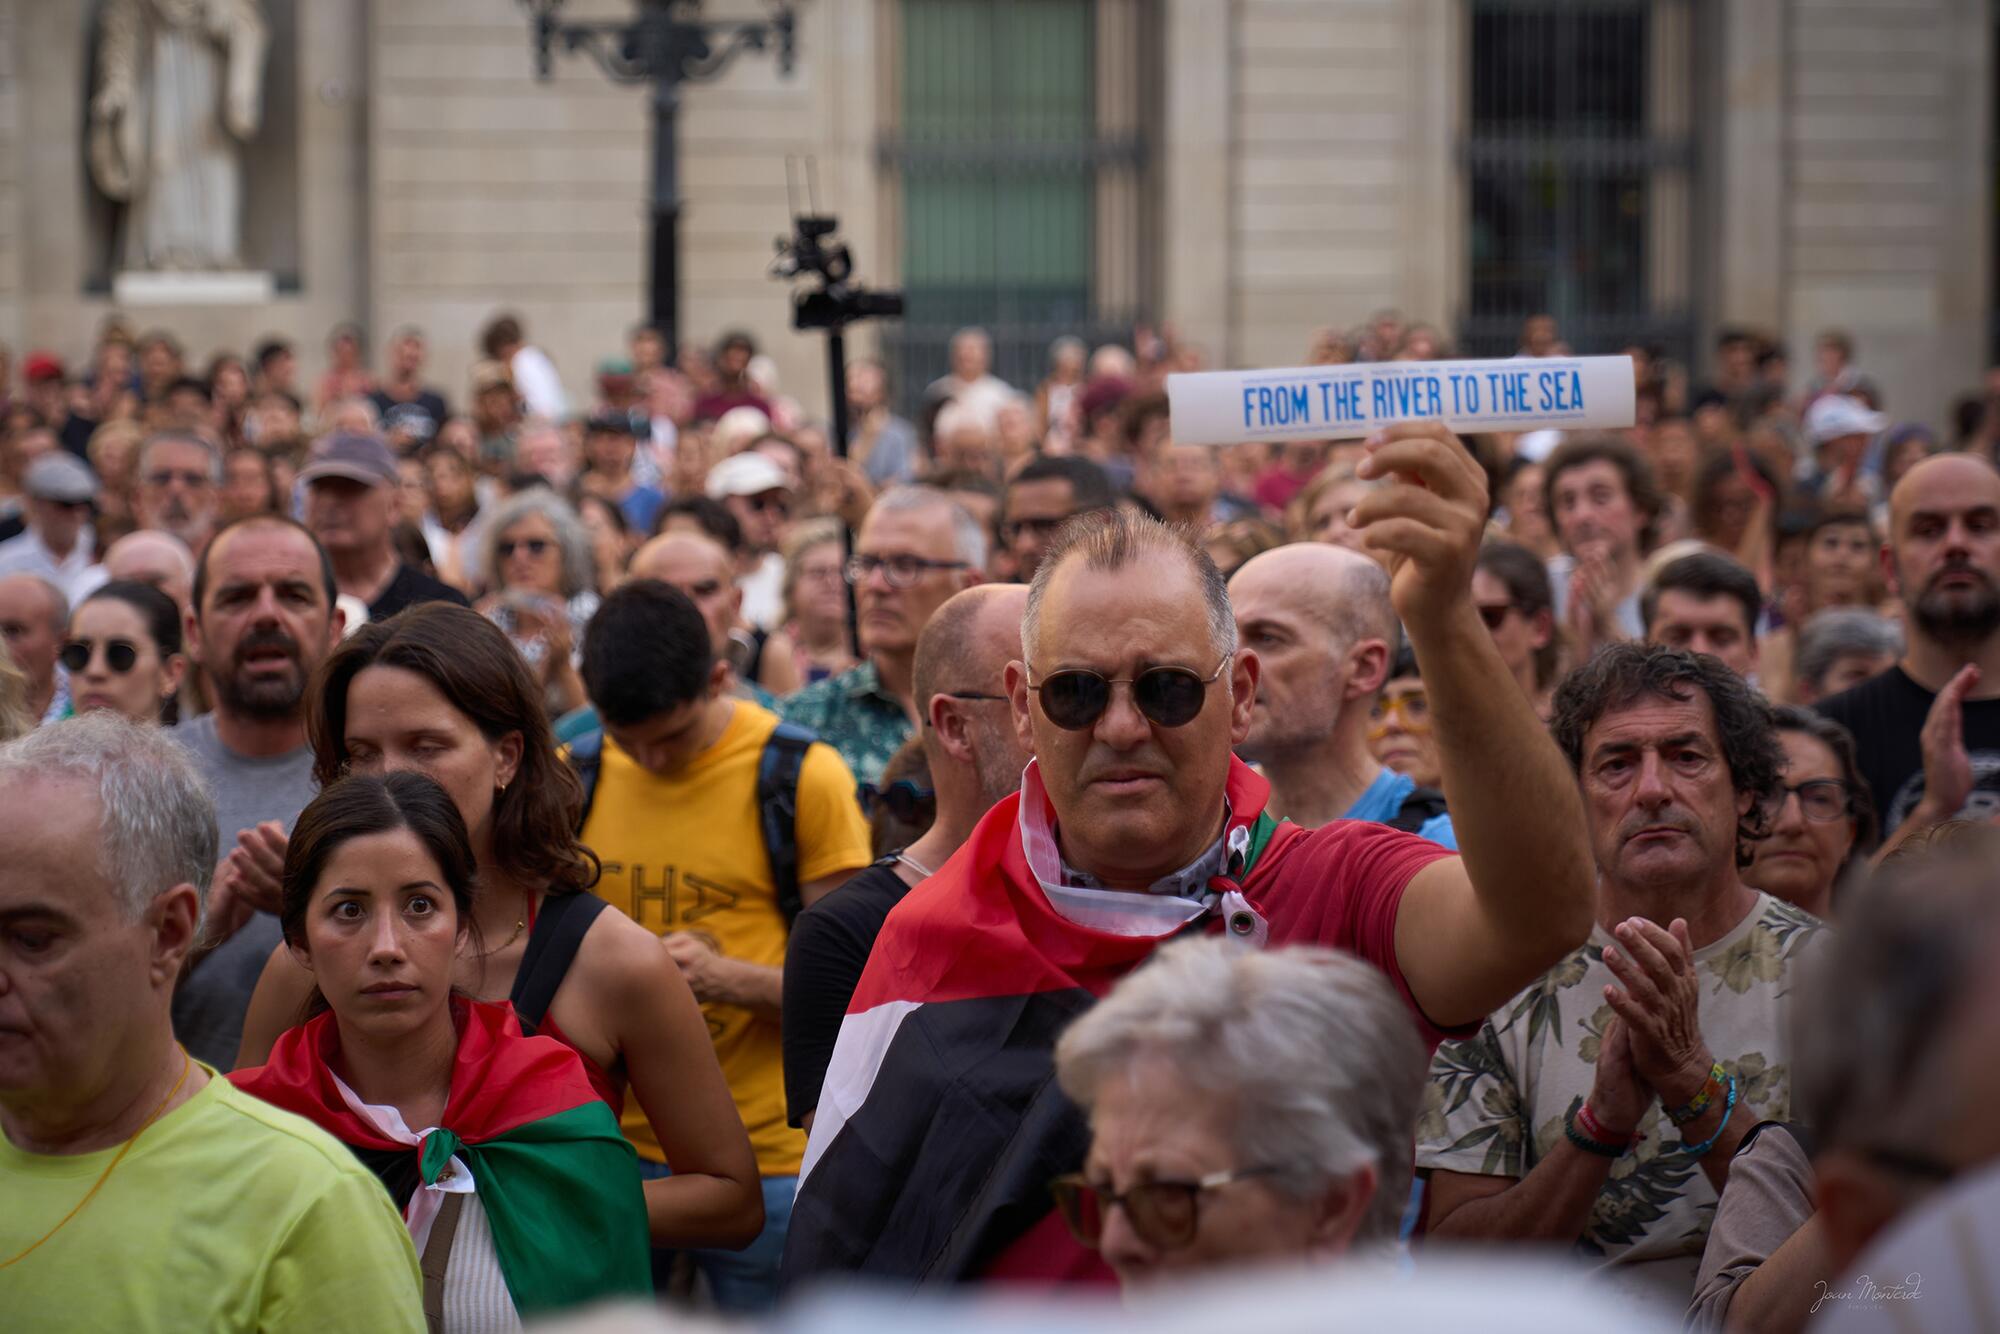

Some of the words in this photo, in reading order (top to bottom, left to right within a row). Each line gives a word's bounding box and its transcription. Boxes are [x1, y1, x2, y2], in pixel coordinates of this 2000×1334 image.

[1243, 385, 1309, 427] FROM
[1318, 381, 1365, 421] THE
[1372, 376, 1442, 418] RIVER
[1448, 374, 1480, 414] TO
[1486, 372, 1532, 412] THE
[1539, 370, 1584, 411] SEA
